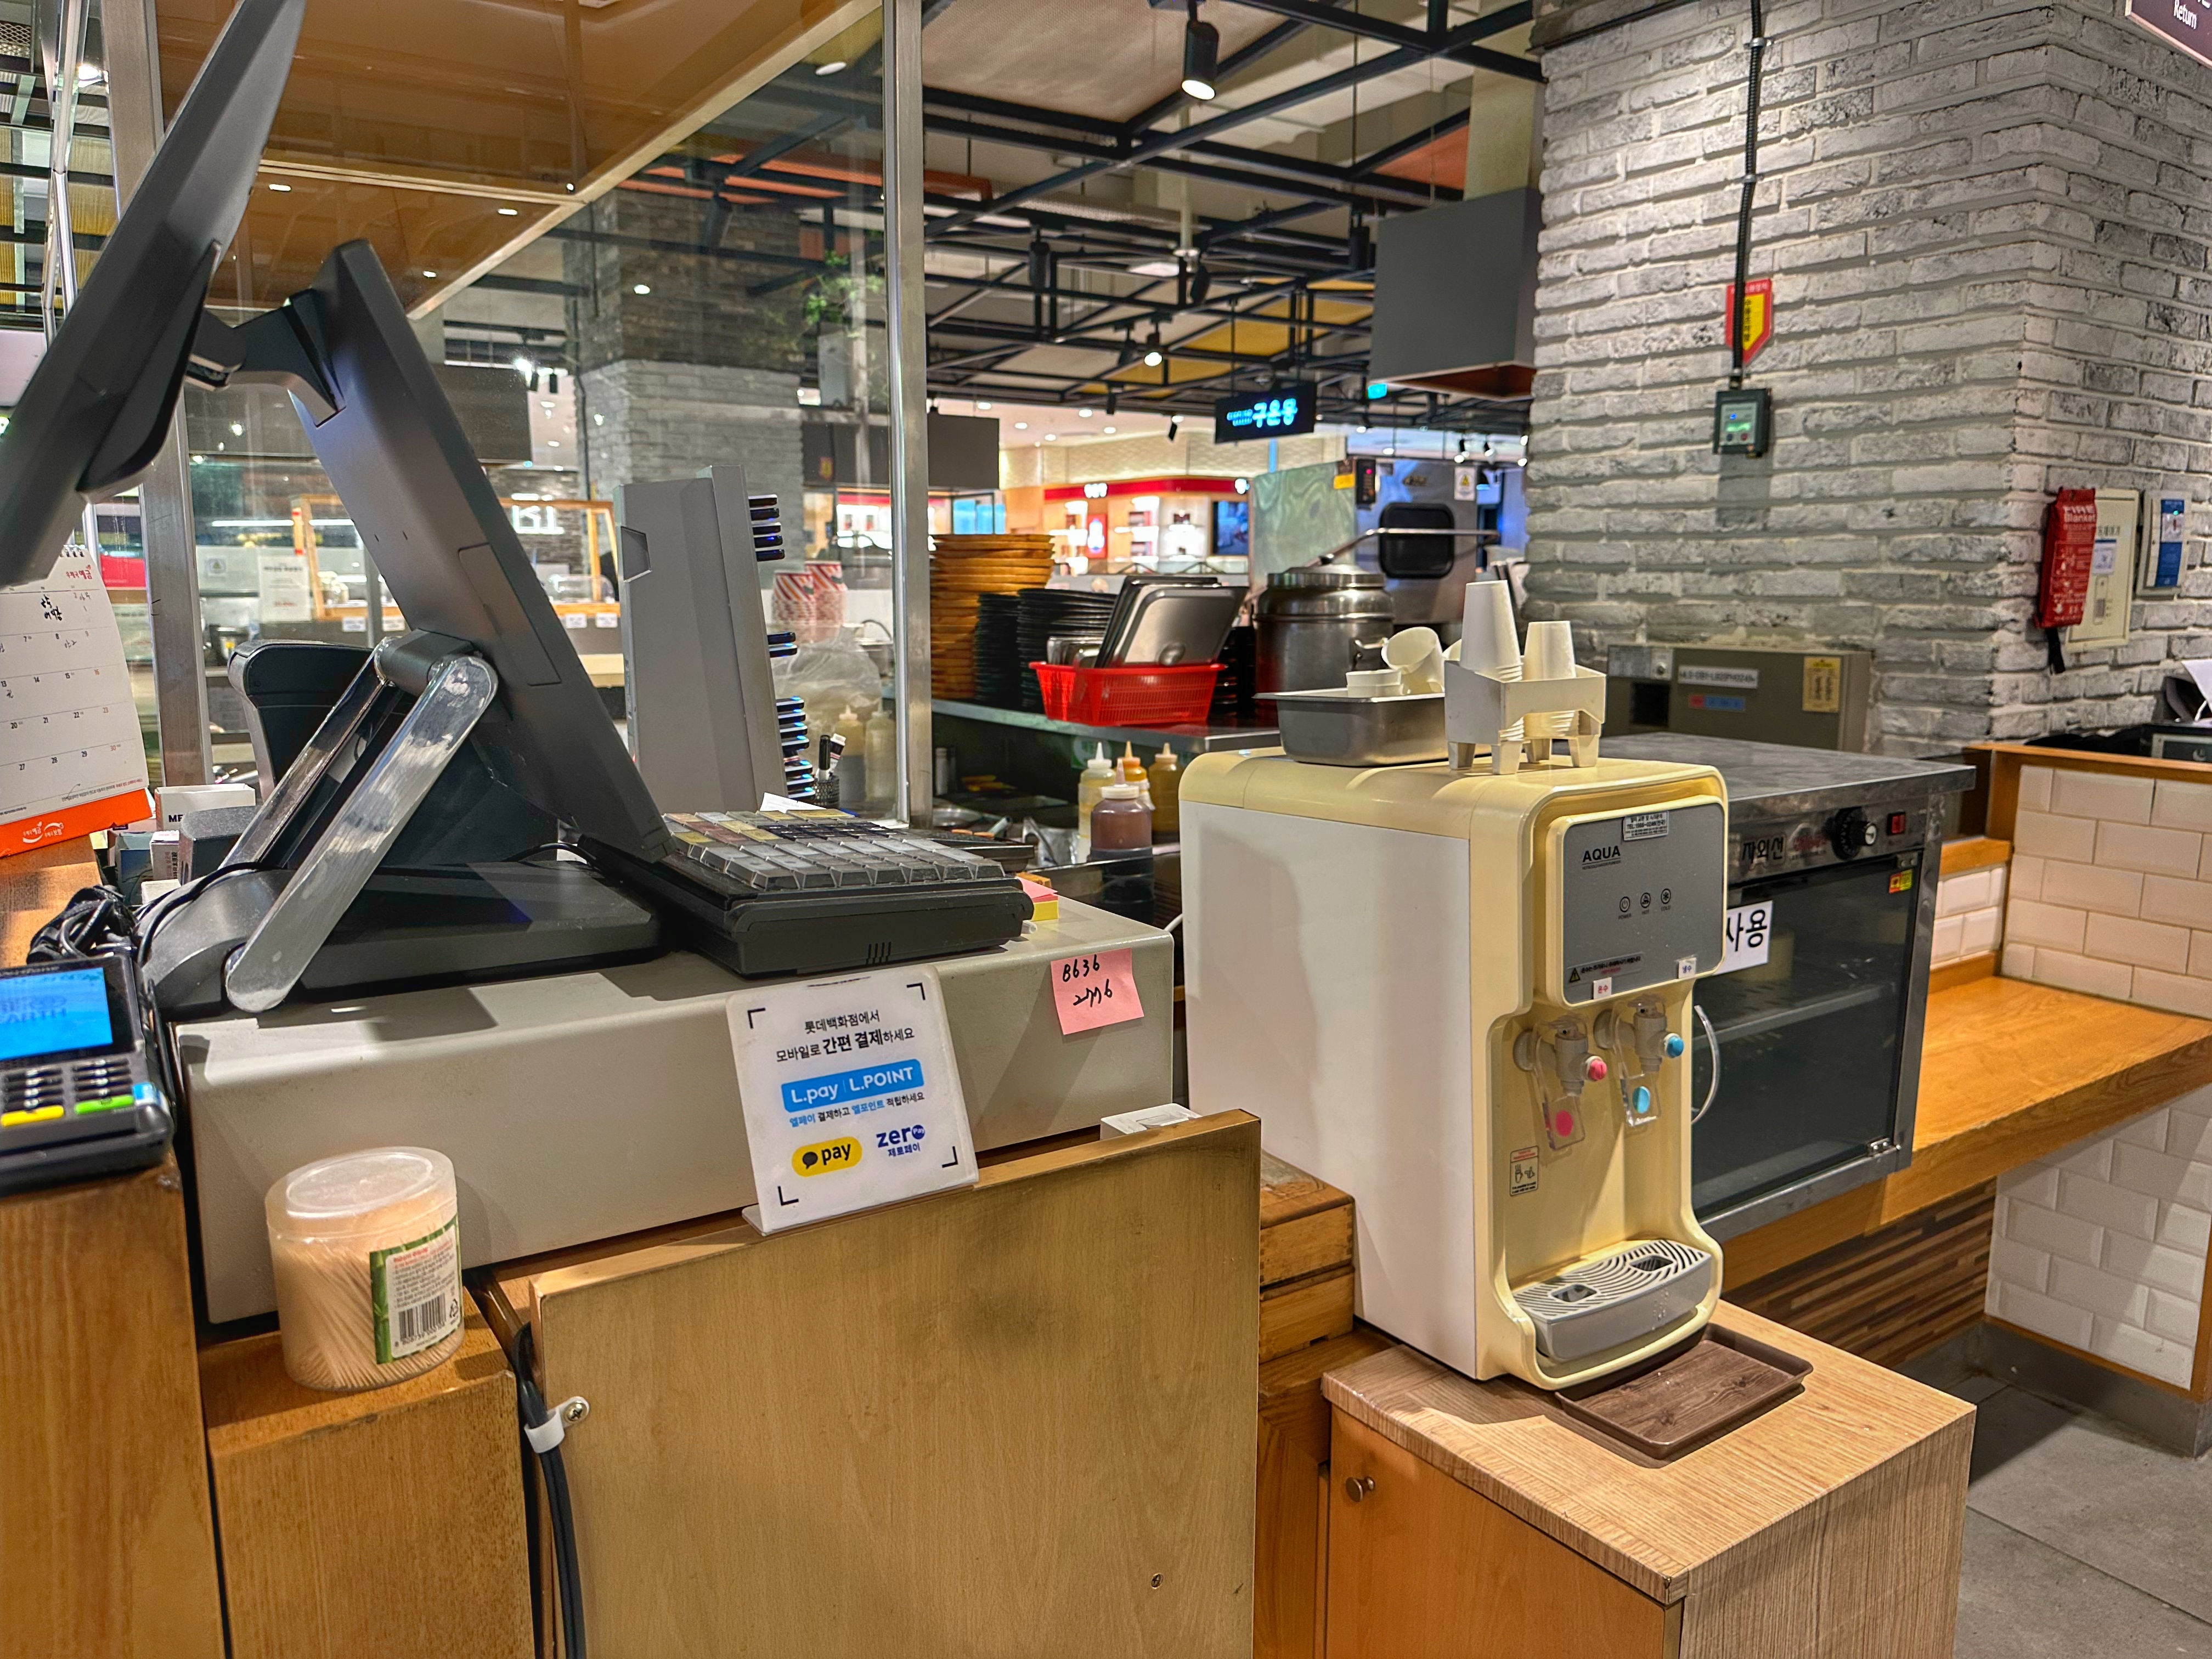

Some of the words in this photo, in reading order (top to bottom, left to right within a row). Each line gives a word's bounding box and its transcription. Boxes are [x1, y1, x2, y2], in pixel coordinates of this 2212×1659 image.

[2174, 0, 2198, 30] Return
[1582, 845, 1621, 863] AQUA
[1742, 837, 1784, 864] 자외선
[1682, 964, 1692, 973] 냉수
[1598, 985, 1609, 994] 온수
[804, 1010, 881, 1034] 롯데백화점에서
[776, 1044, 822, 1062] 모바일로
[823, 1034, 853, 1055] 간편
[855, 1028, 915, 1048] 결제하세요
[791, 1084, 838, 1104] L.pay
[849, 1067, 913, 1092] L.POINT
[789, 1114, 816, 1127] 엘페이
[817, 1107, 850, 1122] 결제하고
[851, 1100, 885, 1115] 엘포인트
[886, 1092, 925, 1107] 적립하세요
[821, 1144, 851, 1165] pay
[888, 1142, 921, 1157] 제로페이
